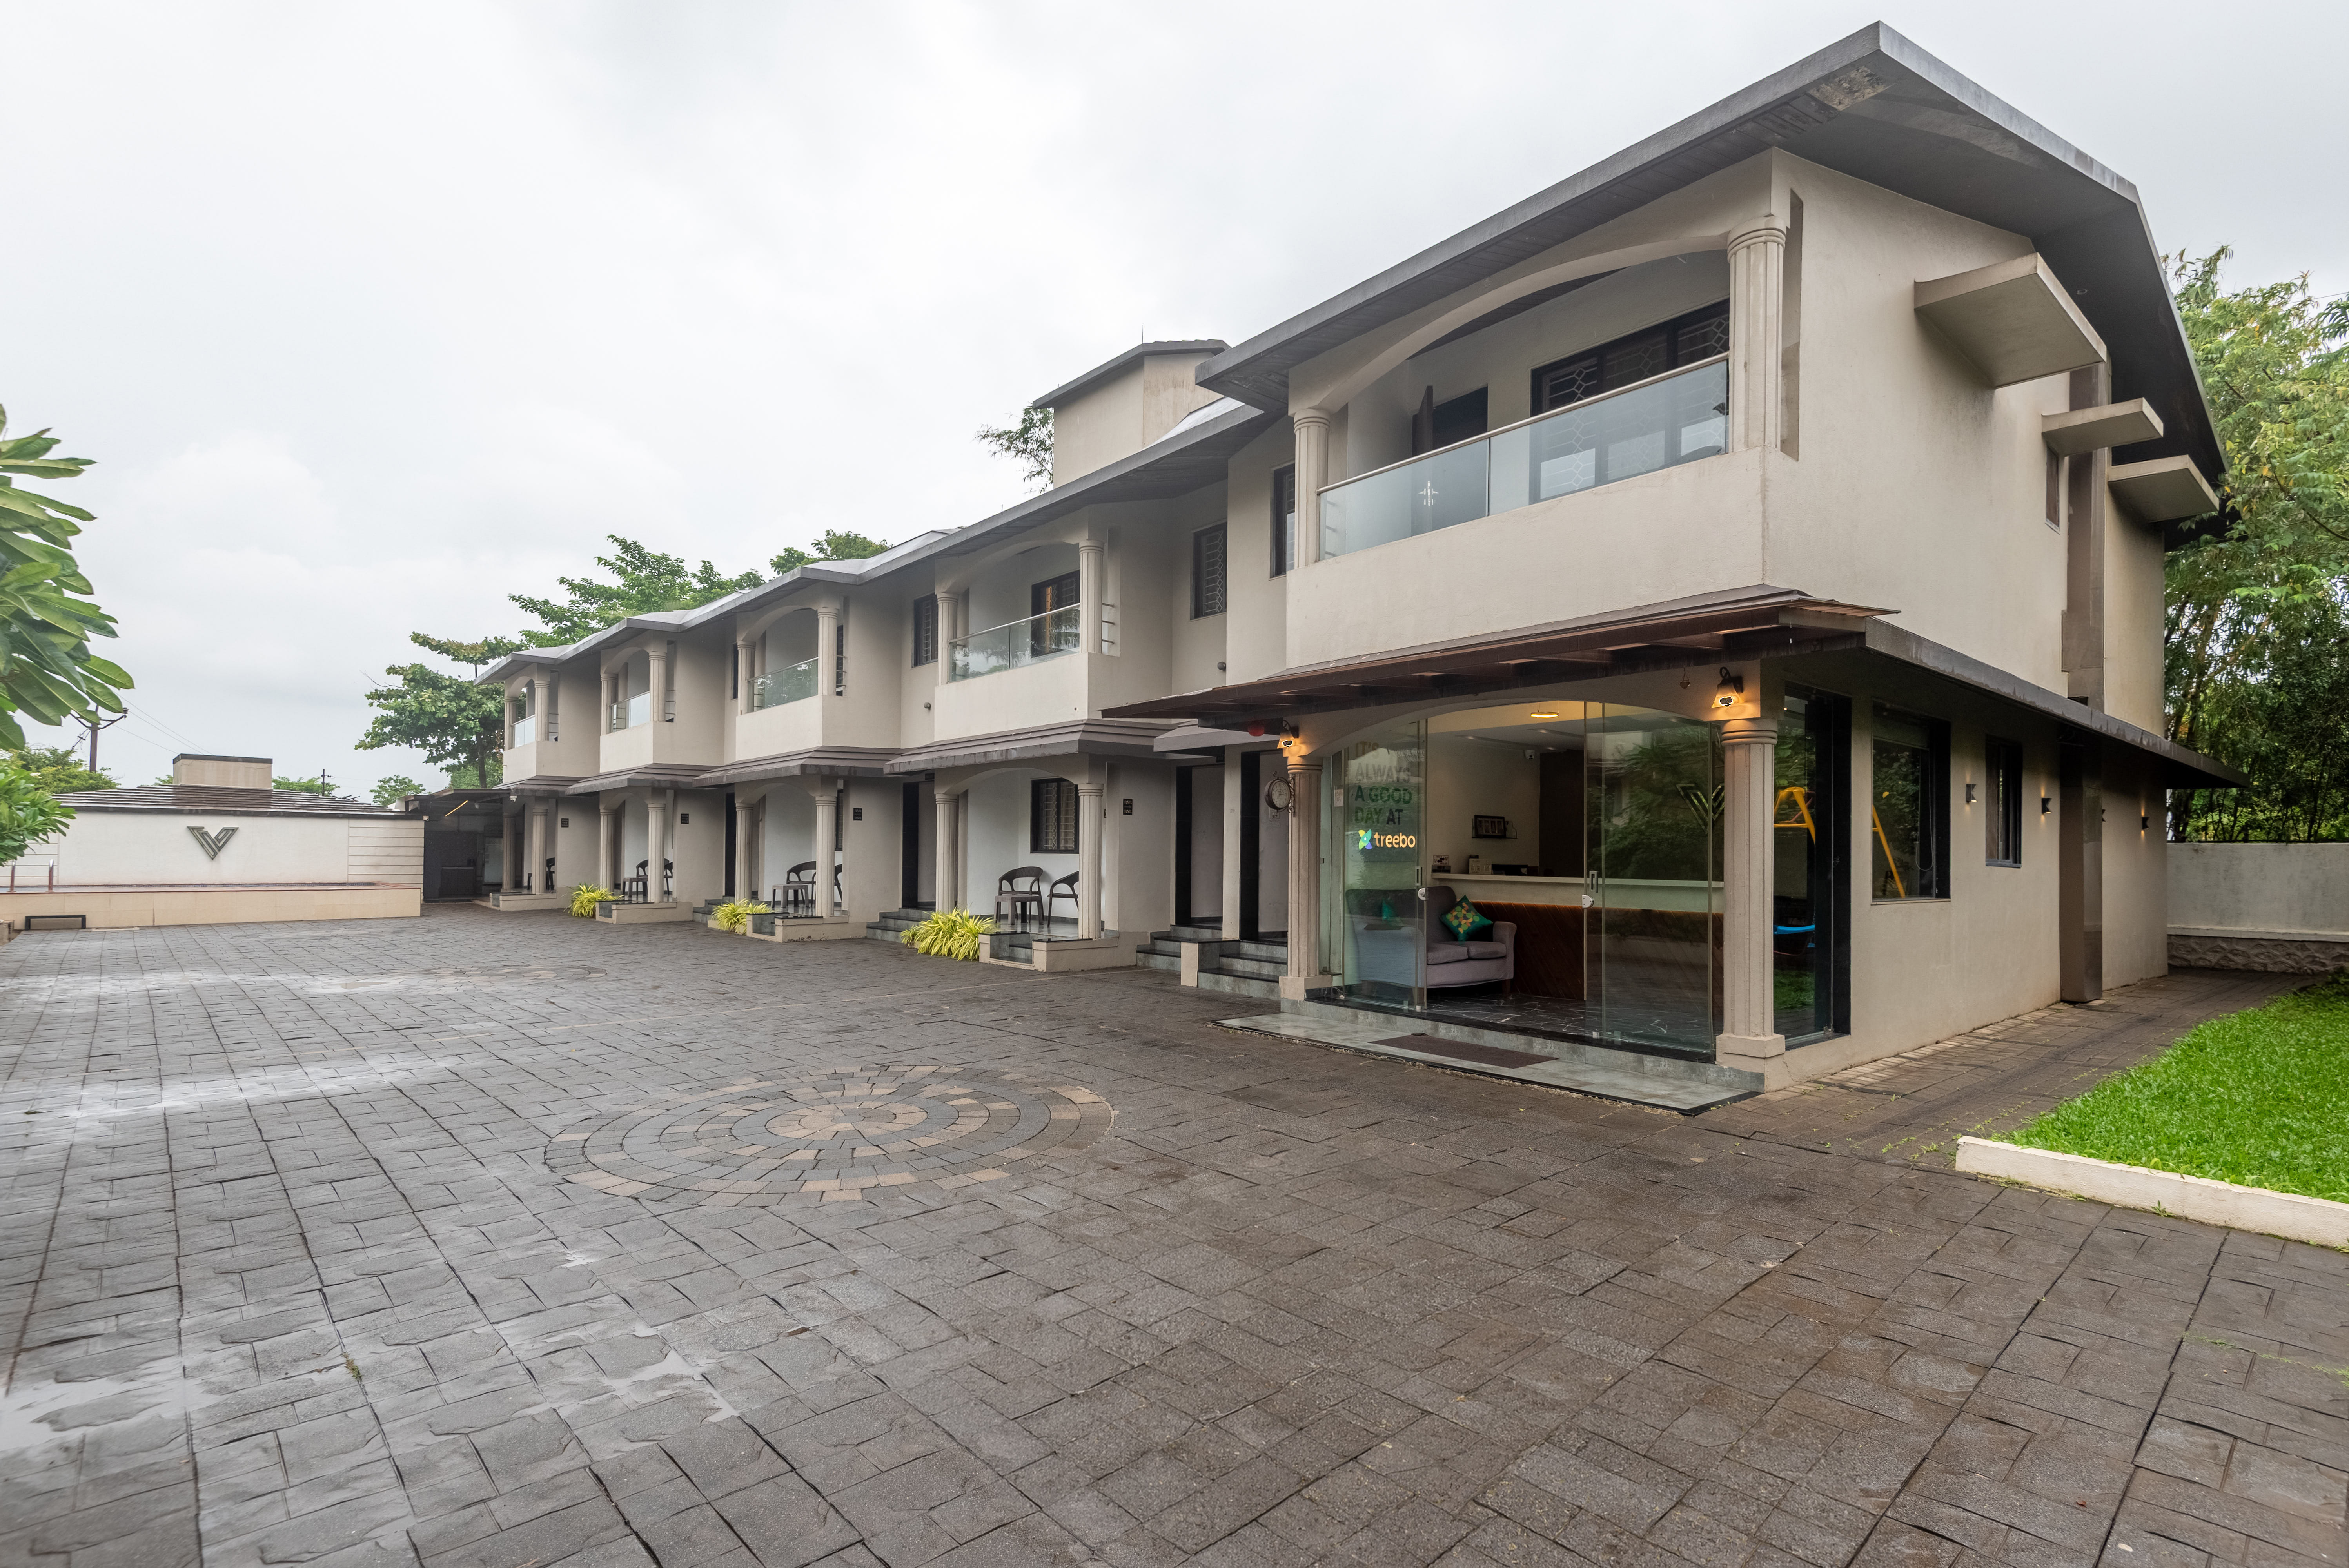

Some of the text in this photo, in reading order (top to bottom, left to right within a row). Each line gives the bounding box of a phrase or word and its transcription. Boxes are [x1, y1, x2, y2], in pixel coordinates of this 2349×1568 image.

[1355, 762, 1411, 783] ALWAYS
[1355, 785, 1365, 802] A
[1369, 785, 1412, 804] GOOD
[1355, 806, 1403, 825] DAY AT
[1374, 832, 1416, 848] treebo
